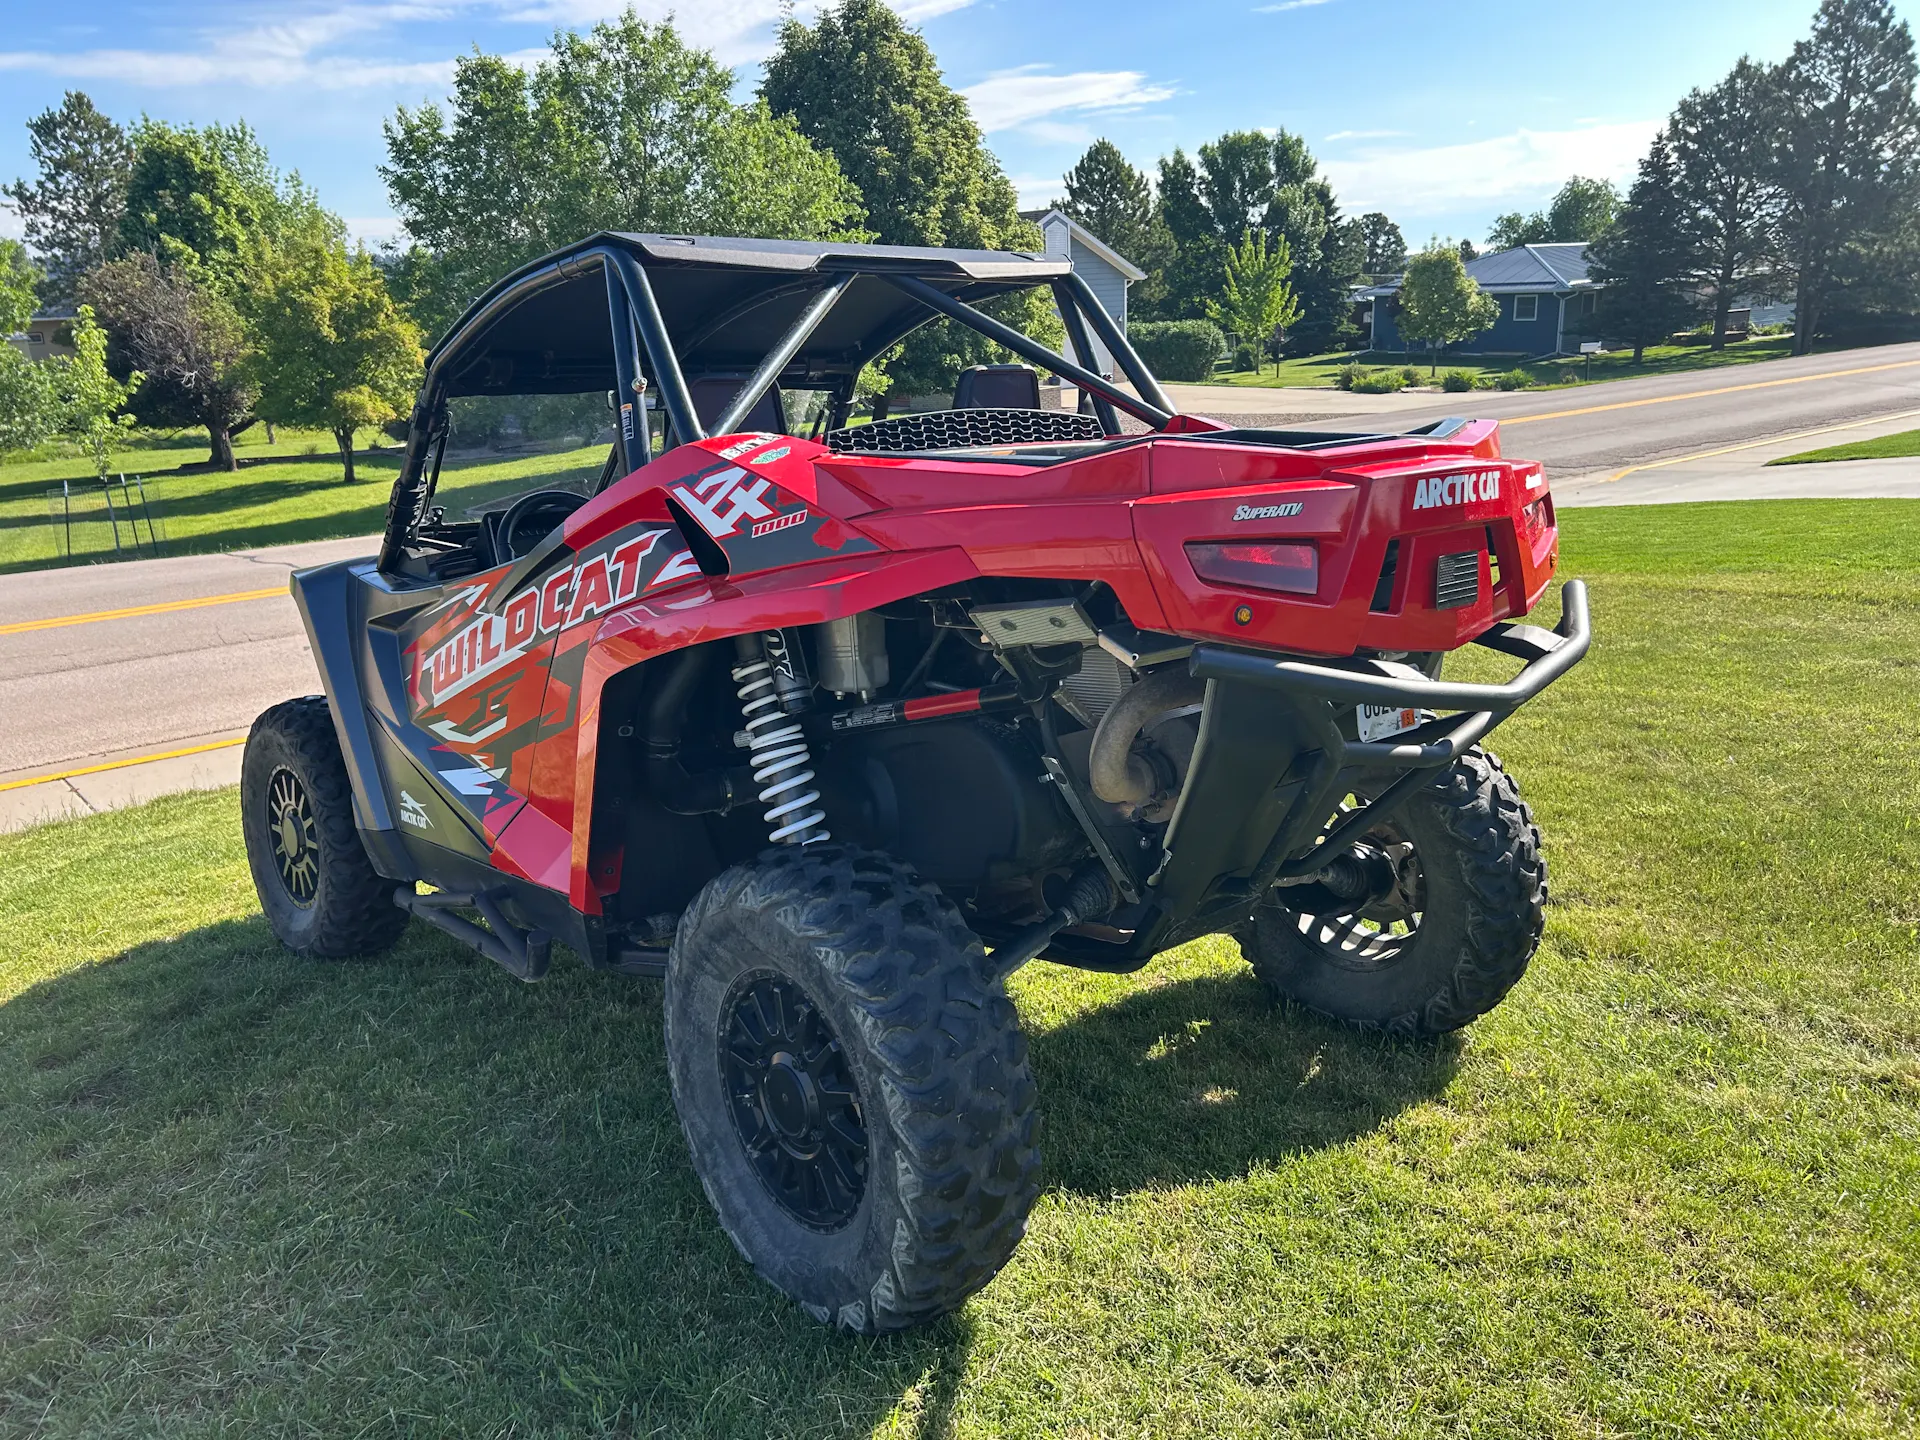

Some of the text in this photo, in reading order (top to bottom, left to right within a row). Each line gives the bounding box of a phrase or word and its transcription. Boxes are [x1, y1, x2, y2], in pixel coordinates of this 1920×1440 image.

[1413, 473, 1477, 510] ARCTIC
[1479, 470, 1500, 502] CAT
[751, 509, 808, 538] 1000
[424, 528, 671, 700] WILDCAT
[400, 809, 427, 830] ARCTIC CAT
